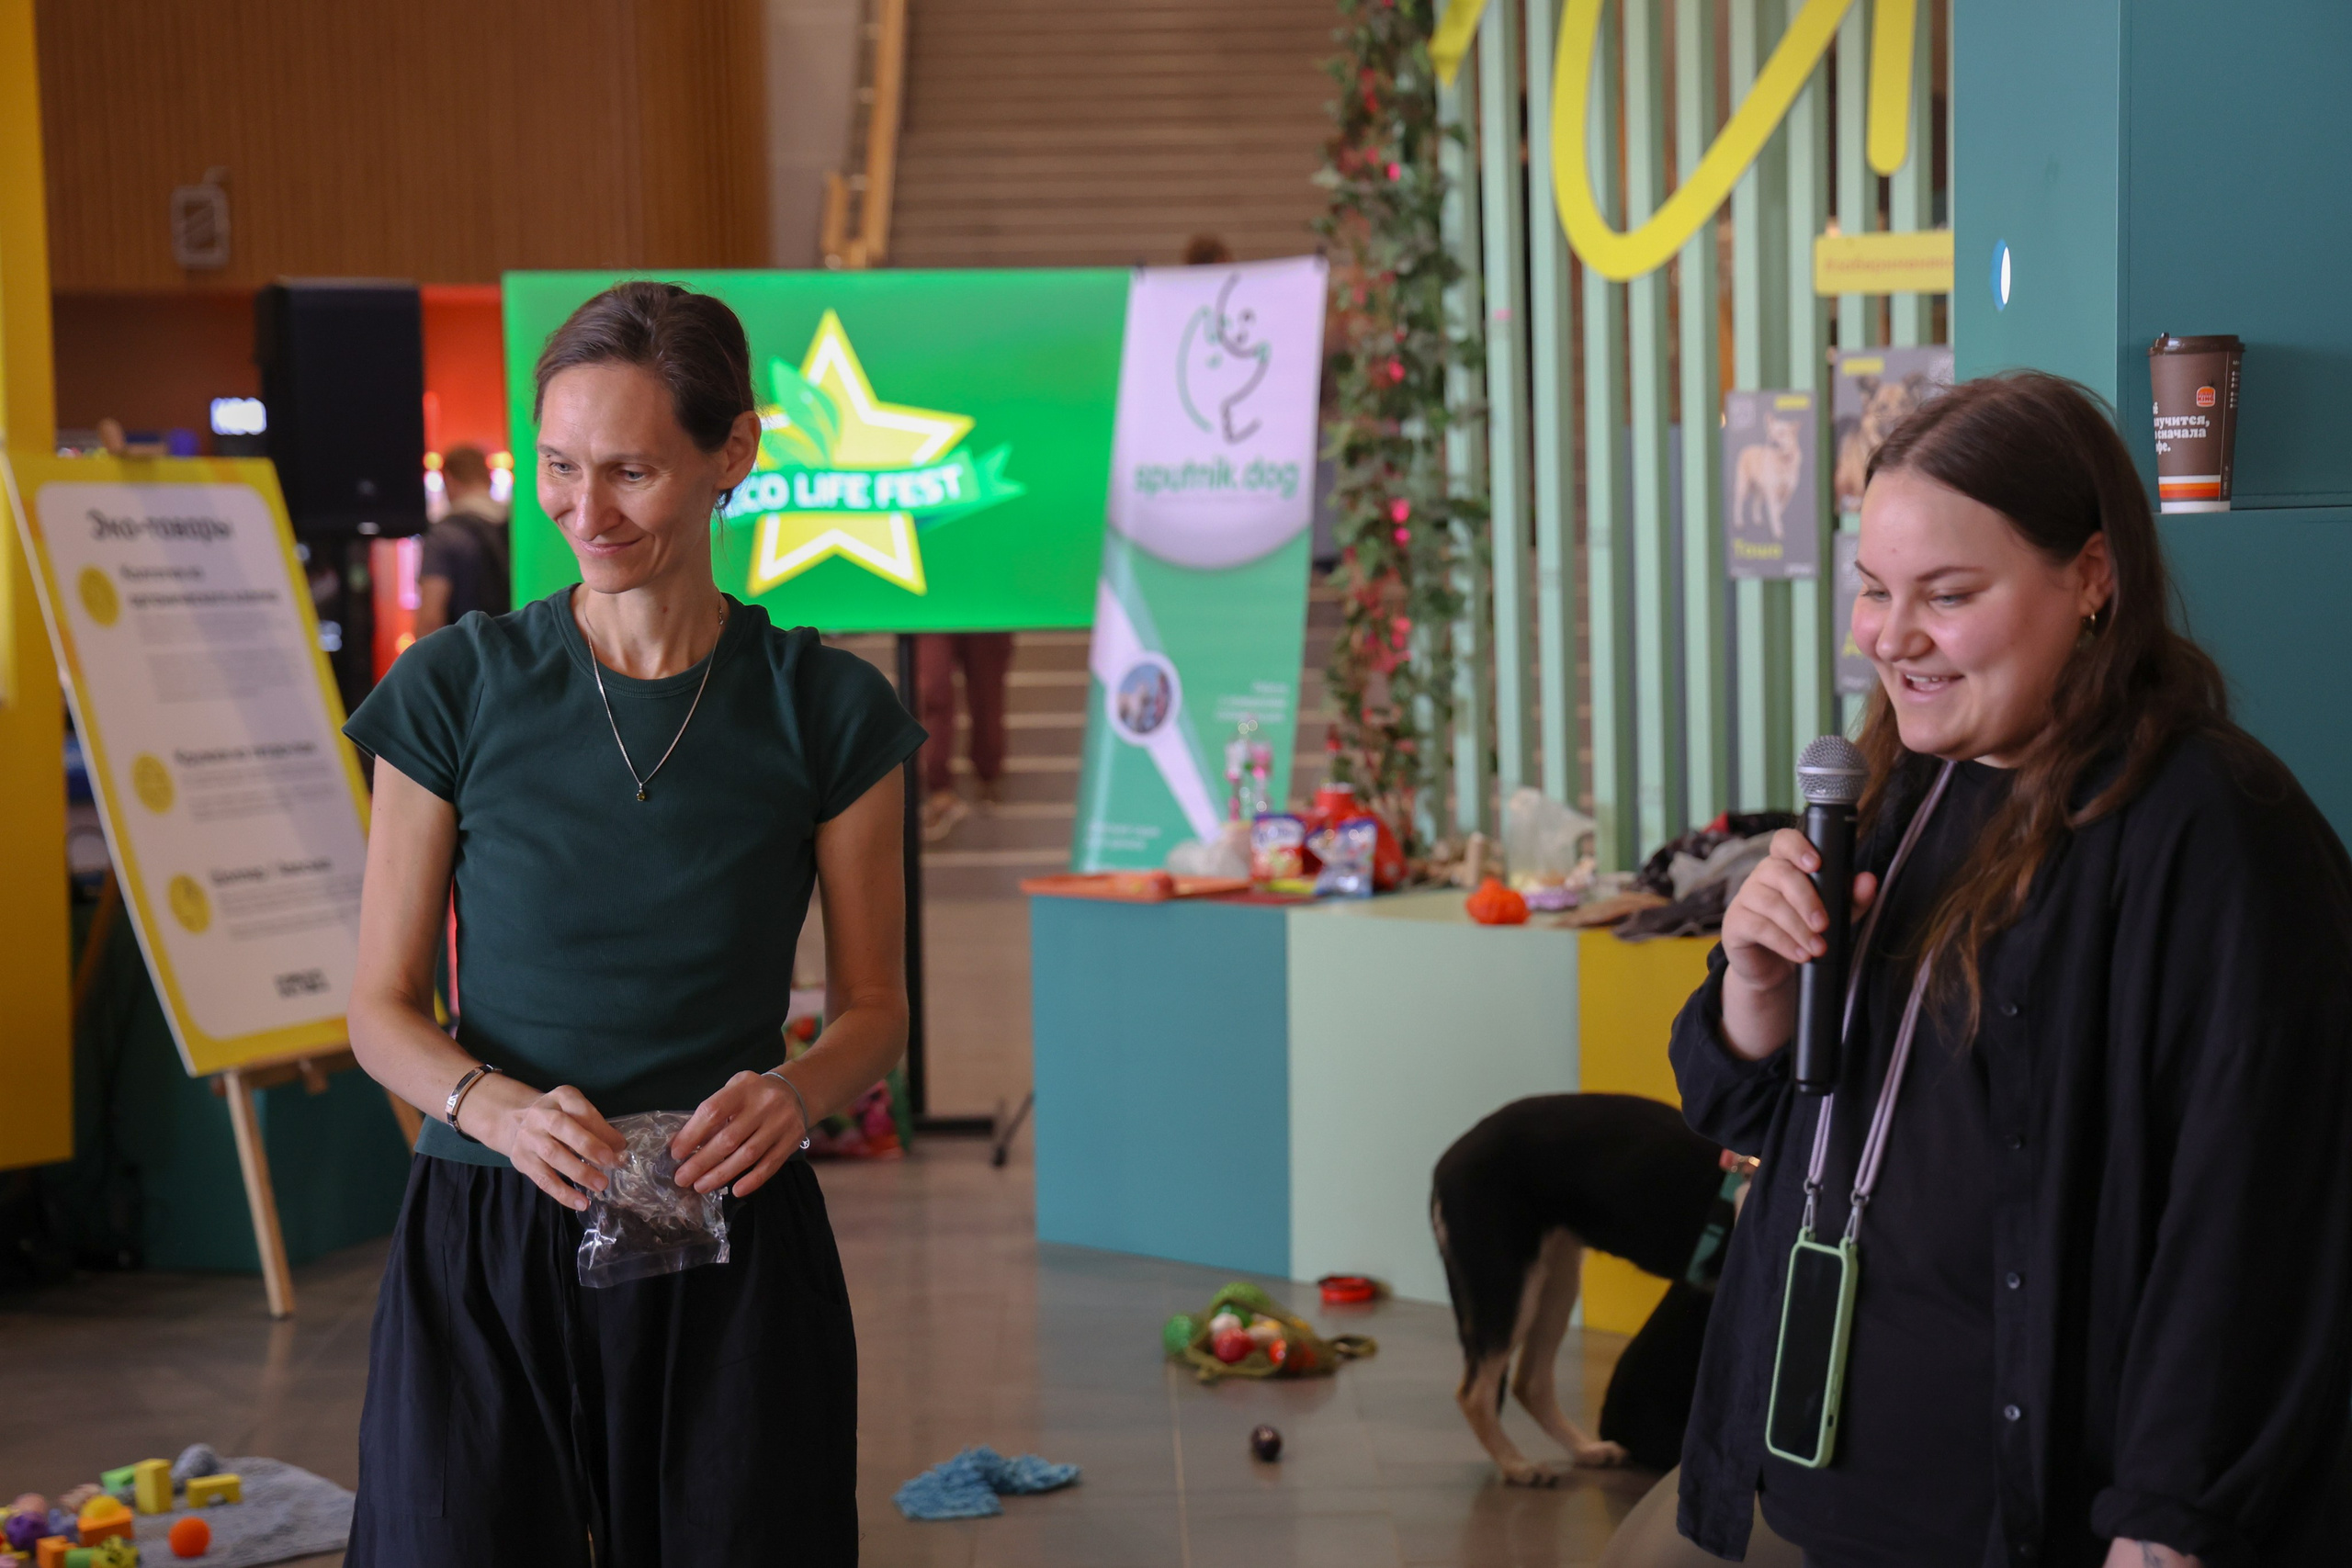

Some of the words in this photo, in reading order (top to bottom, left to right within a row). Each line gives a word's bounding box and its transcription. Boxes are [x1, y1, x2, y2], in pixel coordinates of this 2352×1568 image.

[2154, 415, 2211, 429] лучится,
[793, 471, 872, 509] LIFE
[874, 463, 963, 510] FEST
[1135, 456, 1300, 500] sputnik.dog
